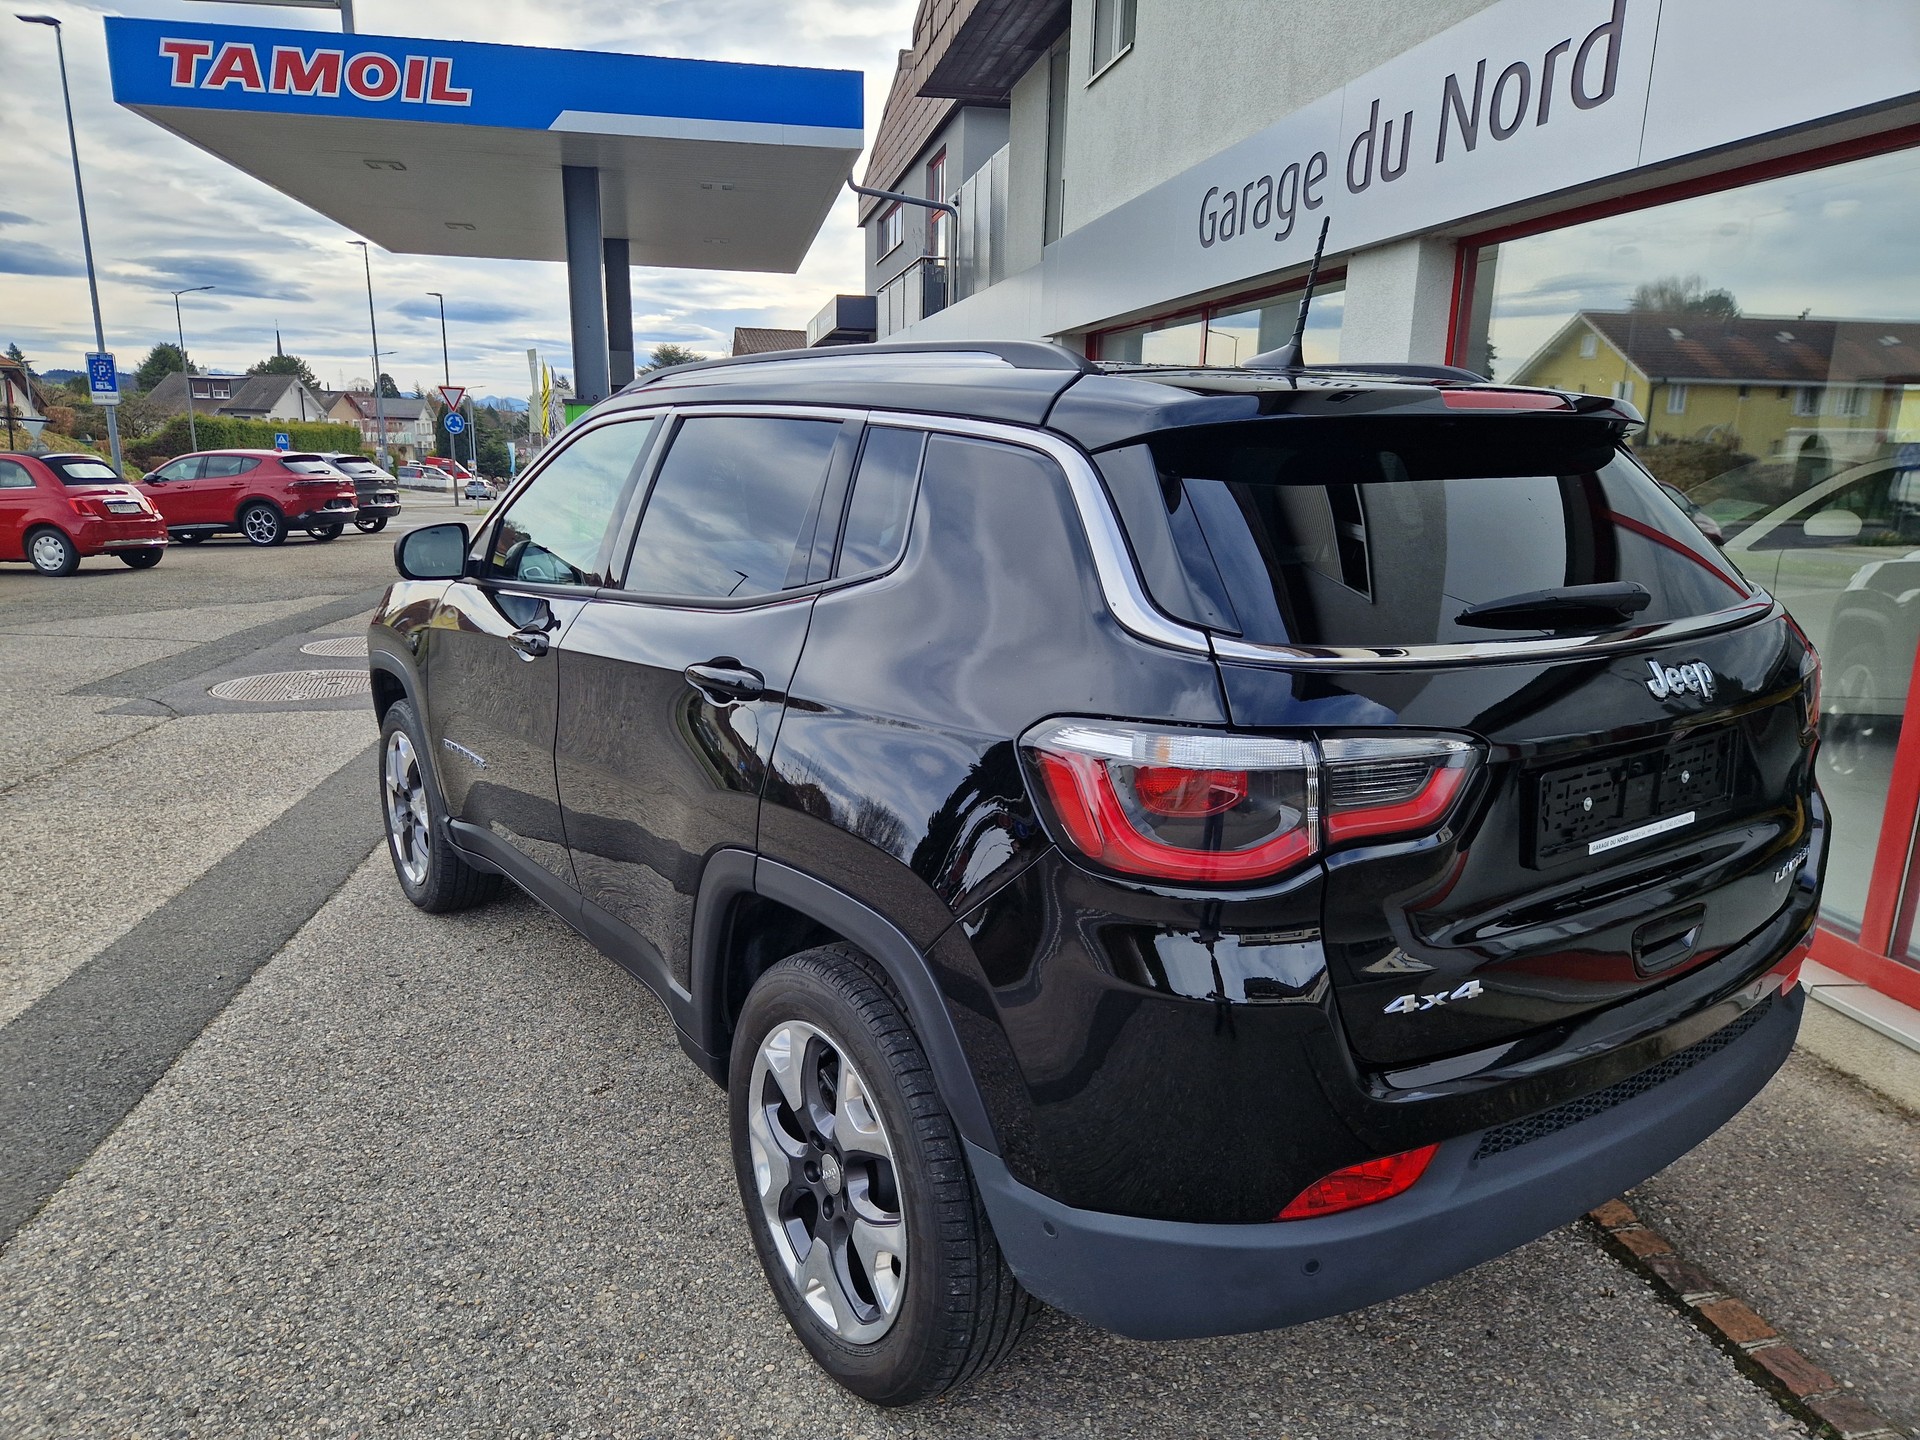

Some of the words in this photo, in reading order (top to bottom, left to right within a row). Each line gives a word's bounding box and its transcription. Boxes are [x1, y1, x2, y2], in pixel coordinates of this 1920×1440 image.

[158, 36, 473, 107] TAMOIL
[1199, 150, 1328, 249] Garage
[1346, 98, 1414, 194] du
[1435, 0, 1626, 164] Nord
[1646, 660, 1714, 699] Jeep
[1383, 979, 1484, 1015] 4x4
